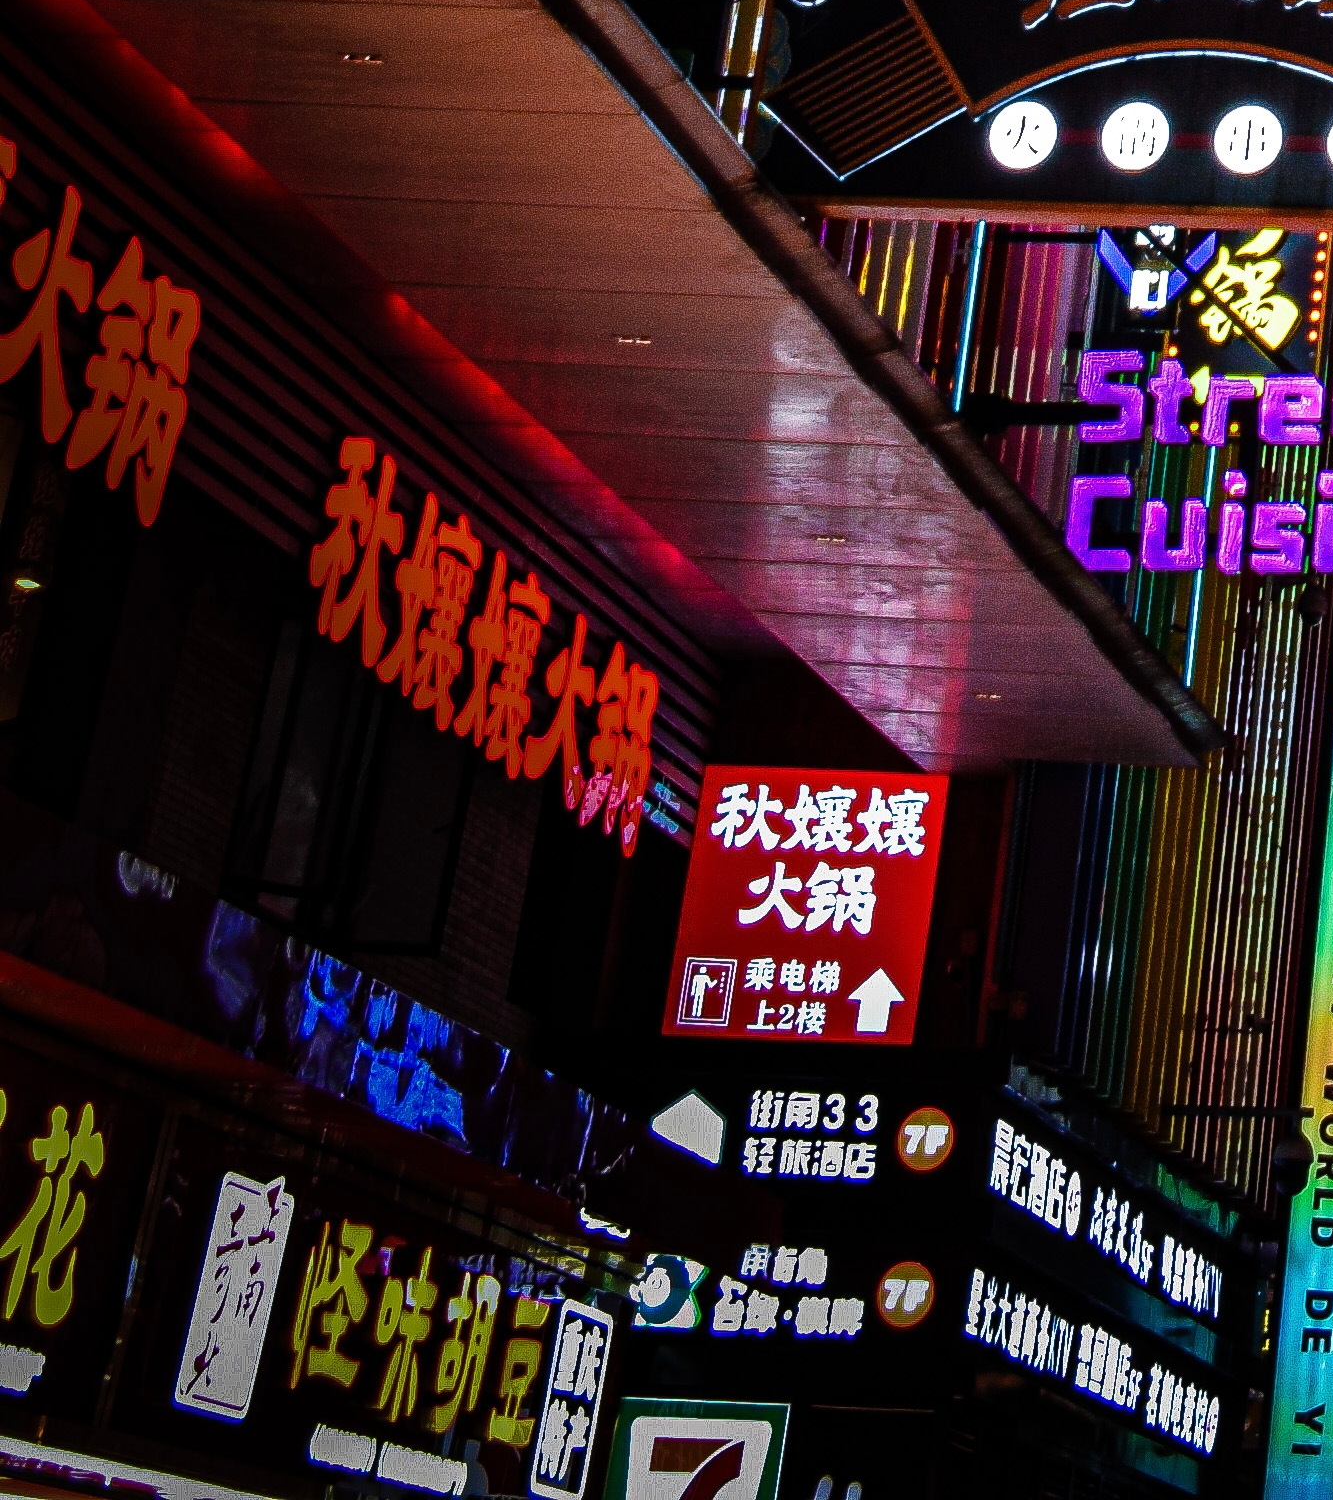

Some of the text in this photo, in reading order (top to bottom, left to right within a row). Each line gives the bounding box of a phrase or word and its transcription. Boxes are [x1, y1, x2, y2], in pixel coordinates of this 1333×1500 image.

[737, 862, 876, 936] 火锅
[745, 957, 841, 993] 乘电梯
[747, 1000, 827, 1034] 上2楼
[743, 1138, 877, 1179] 轻旅酒店
[904, 1125, 949, 1155] 7F
[883, 1279, 929, 1312] 7F
[291, 1219, 548, 1446] 怪味胡豆
[1290, 1407, 1326, 1457] YI
